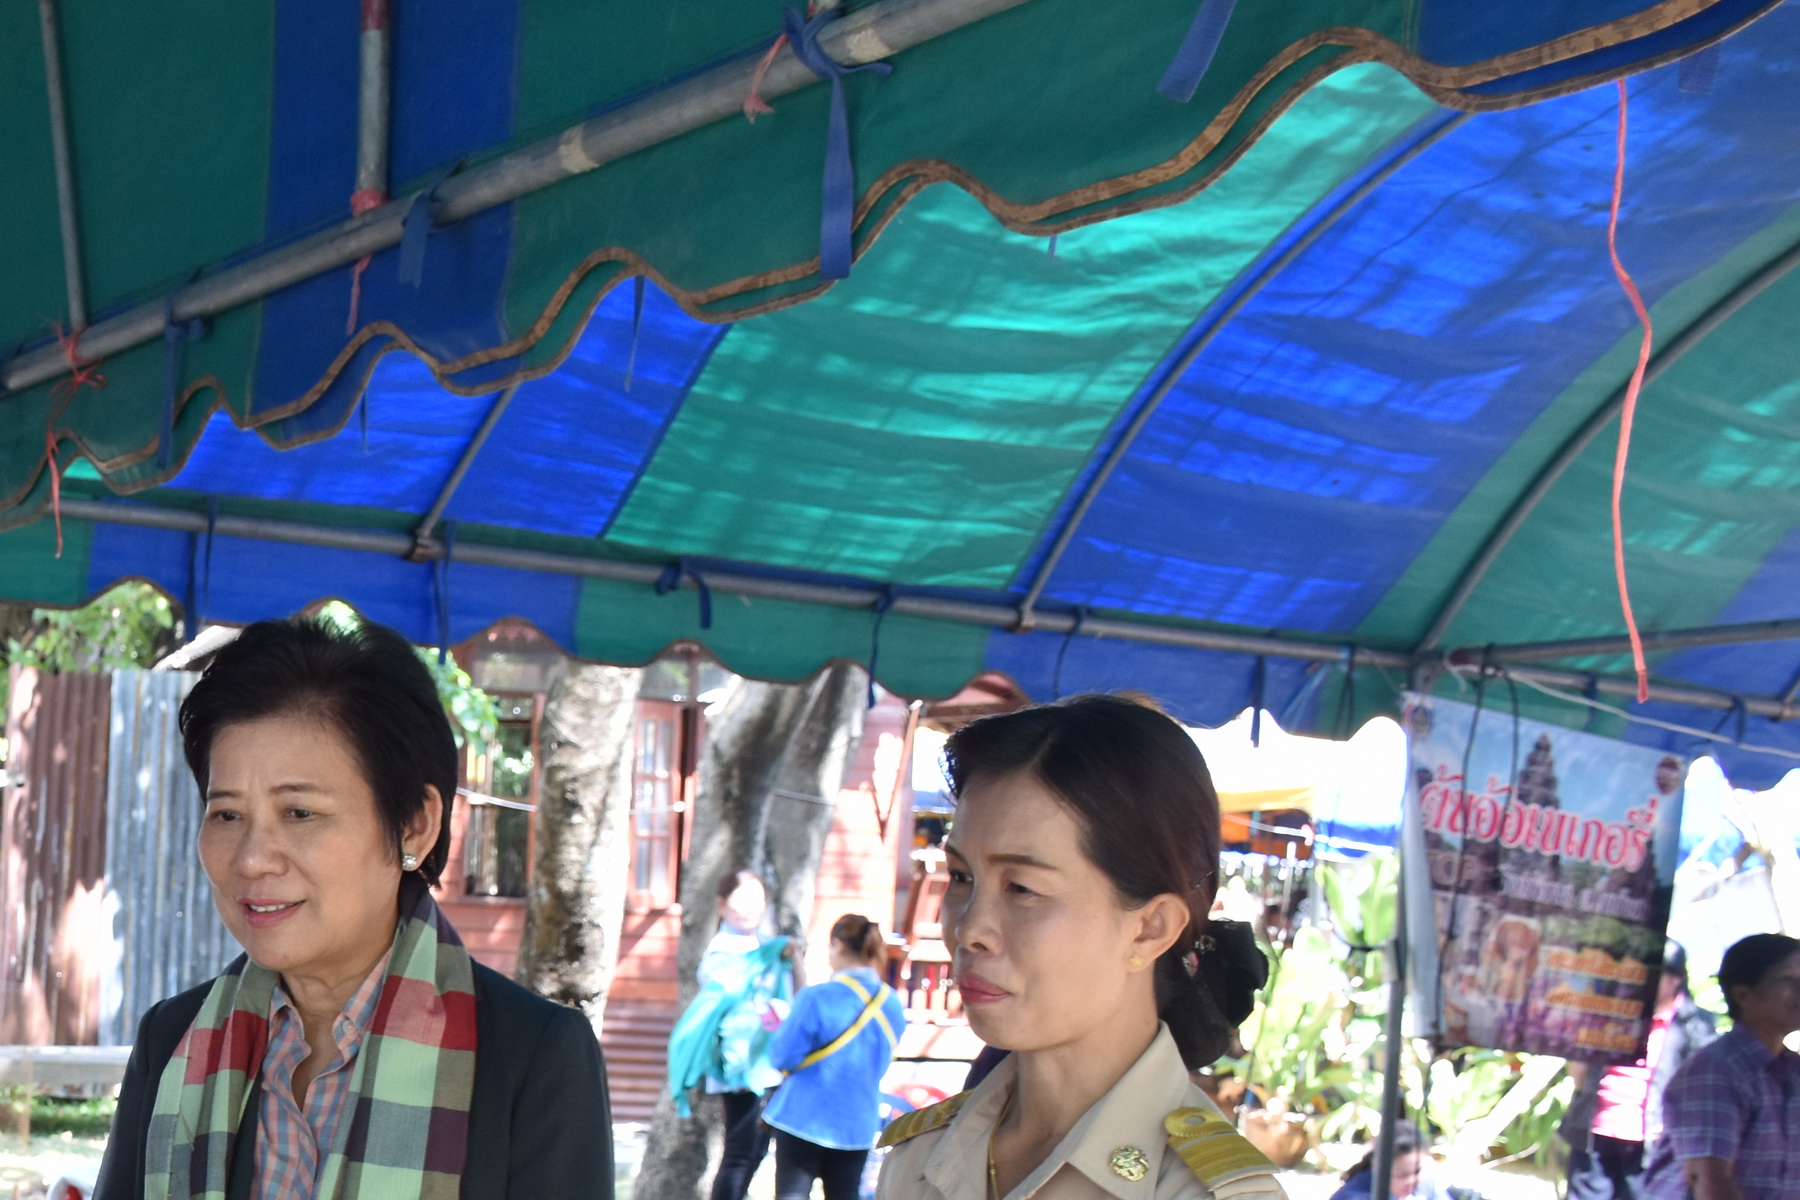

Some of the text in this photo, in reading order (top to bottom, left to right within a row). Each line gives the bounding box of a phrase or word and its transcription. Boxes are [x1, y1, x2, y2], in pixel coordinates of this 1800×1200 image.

[1418, 763, 1659, 873] ต้นอ้อเบเกอรี่
